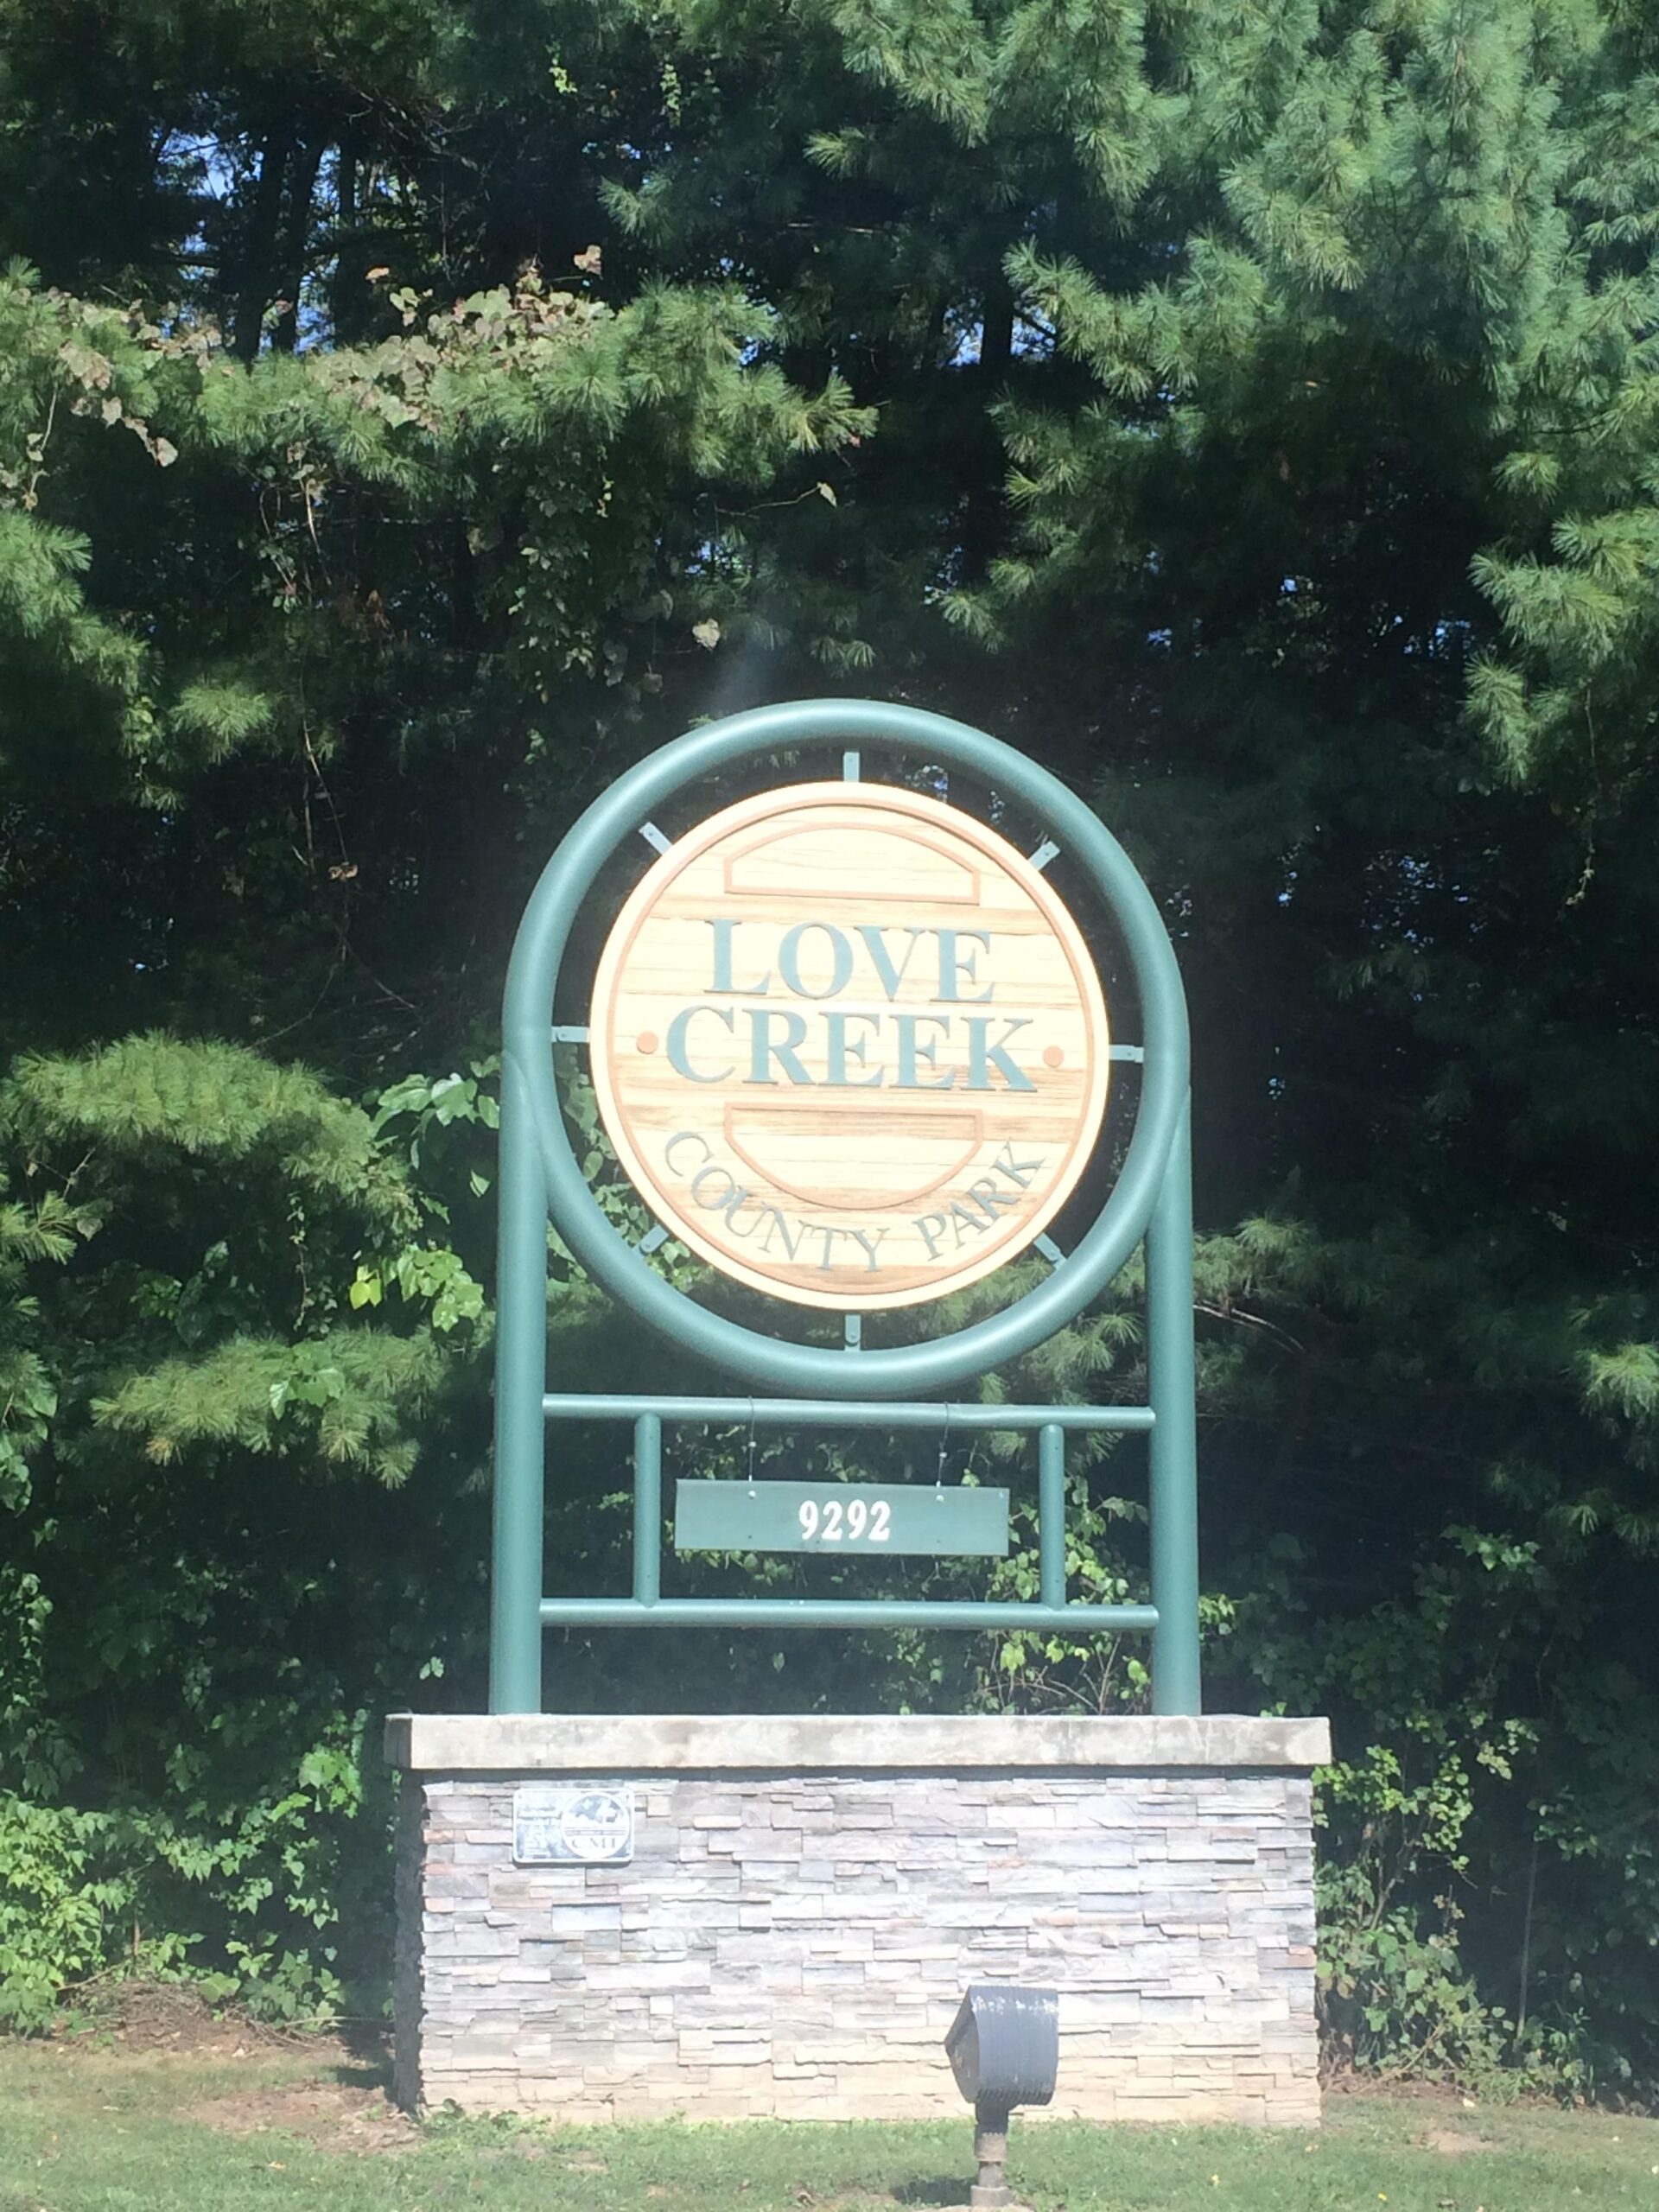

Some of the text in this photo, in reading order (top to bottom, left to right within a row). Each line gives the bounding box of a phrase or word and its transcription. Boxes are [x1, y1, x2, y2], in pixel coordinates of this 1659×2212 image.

[704, 918, 995, 1003] LOVE
[665, 1005, 1038, 1092] CREEK
[664, 1131, 1046, 1273] COUNTY PARK
[798, 1499, 891, 1541] 9292
